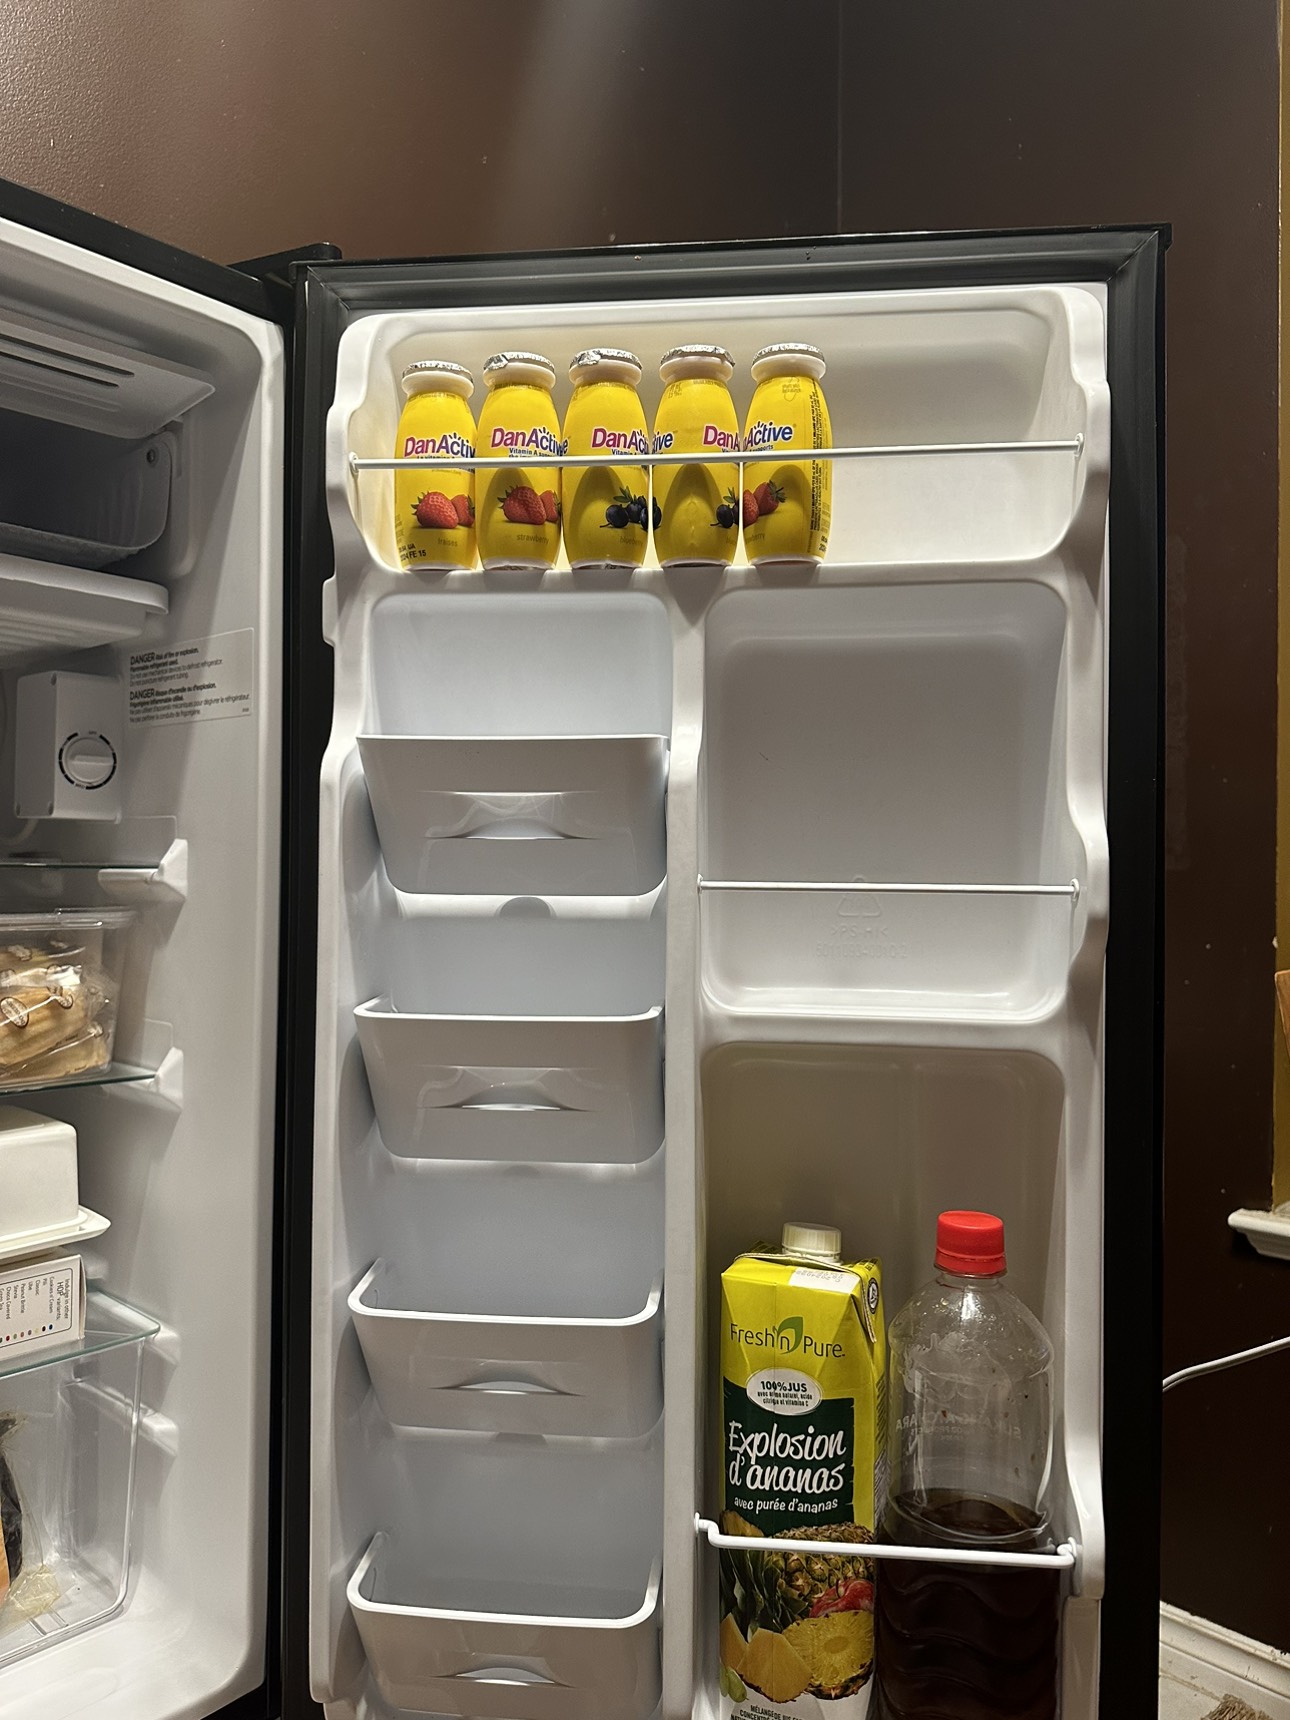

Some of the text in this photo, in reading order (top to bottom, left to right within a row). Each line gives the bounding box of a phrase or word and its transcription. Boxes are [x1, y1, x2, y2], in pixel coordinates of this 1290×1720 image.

[592, 428, 648, 454] DanAc
[744, 421, 793, 450] Active
[404, 432, 476, 458] DanActiv
[516, 534, 549, 544] strawberry
[130, 652, 155, 665] DANGER
[130, 689, 155, 701] DANGER
[56, 1281, 65, 1296] HOP
[729, 1420, 847, 1465] Explosion
[734, 1497, 754, 1510] avec
[756, 1497, 786, 1515] purée
